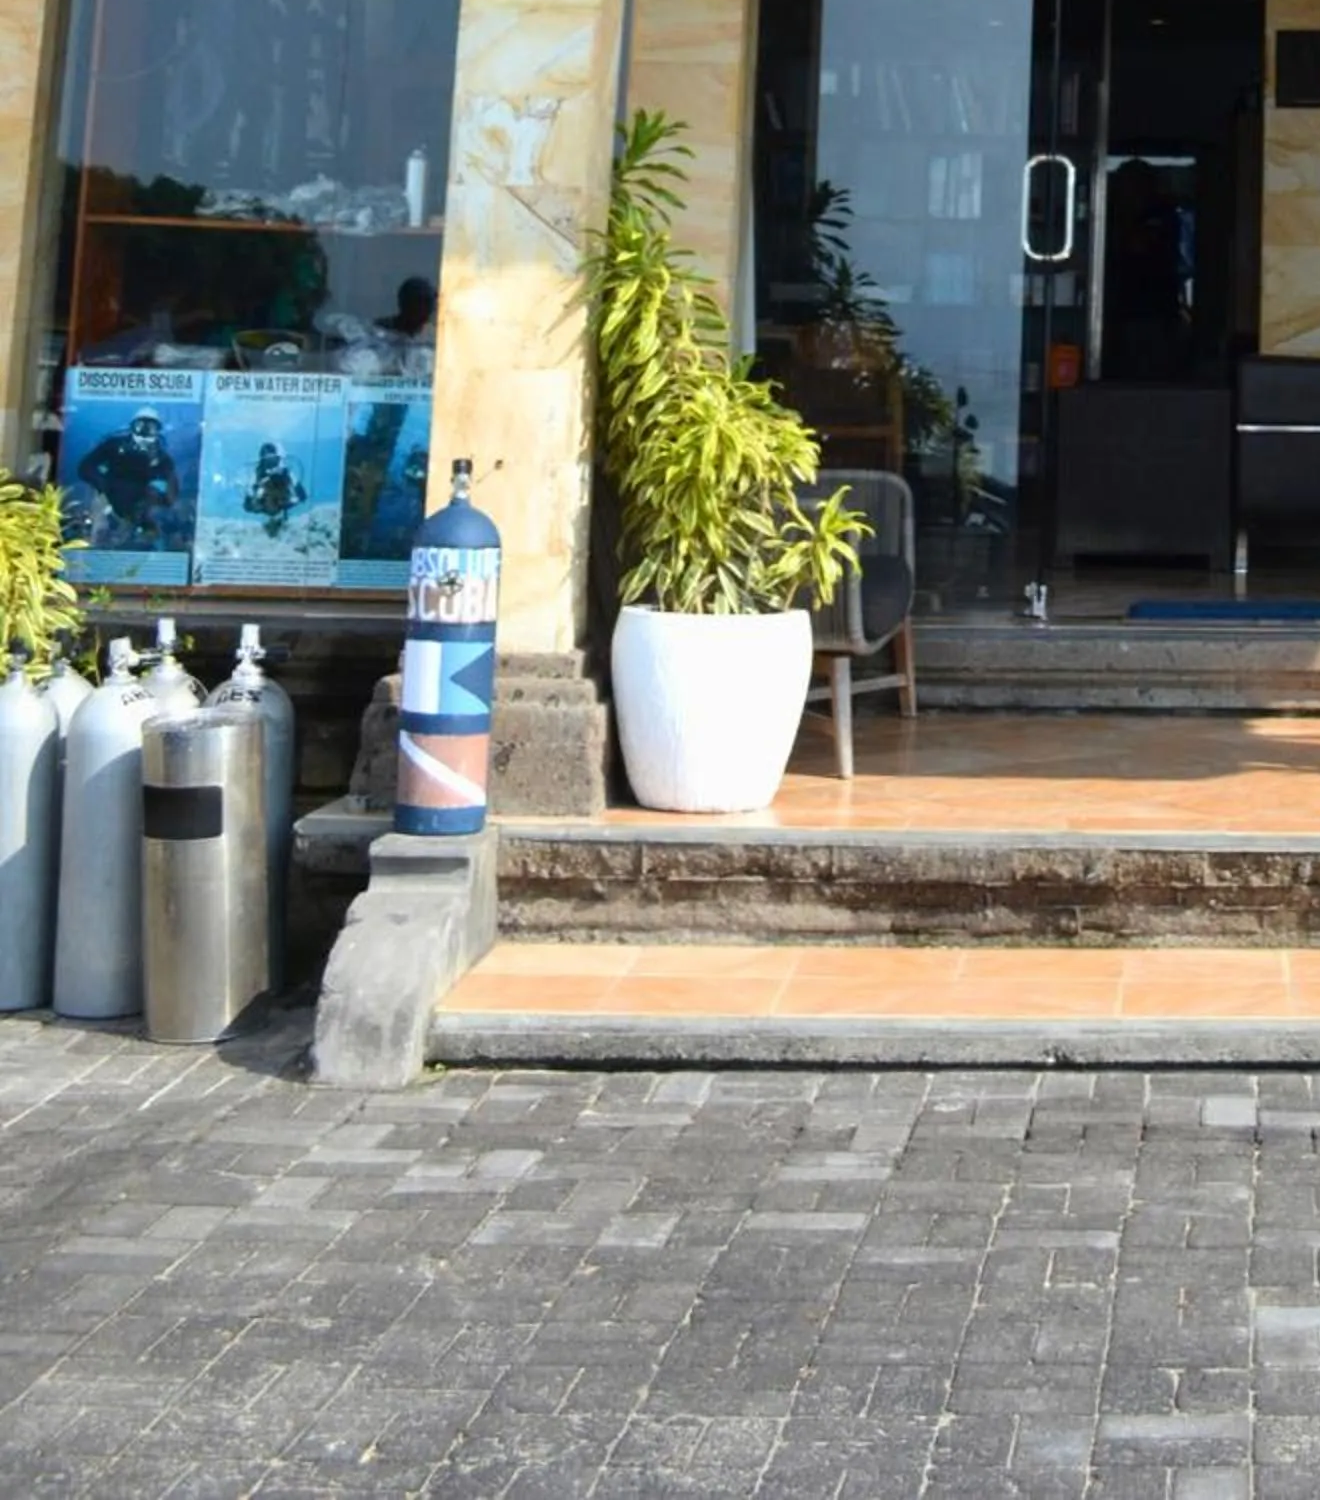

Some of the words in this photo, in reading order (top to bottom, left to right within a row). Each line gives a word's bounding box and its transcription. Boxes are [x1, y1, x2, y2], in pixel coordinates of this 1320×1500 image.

[79, 371, 146, 389] DISCOVER
[148, 373, 194, 390] SCUBA
[215, 375, 251, 391] OPEN
[254, 377, 299, 393] WATER
